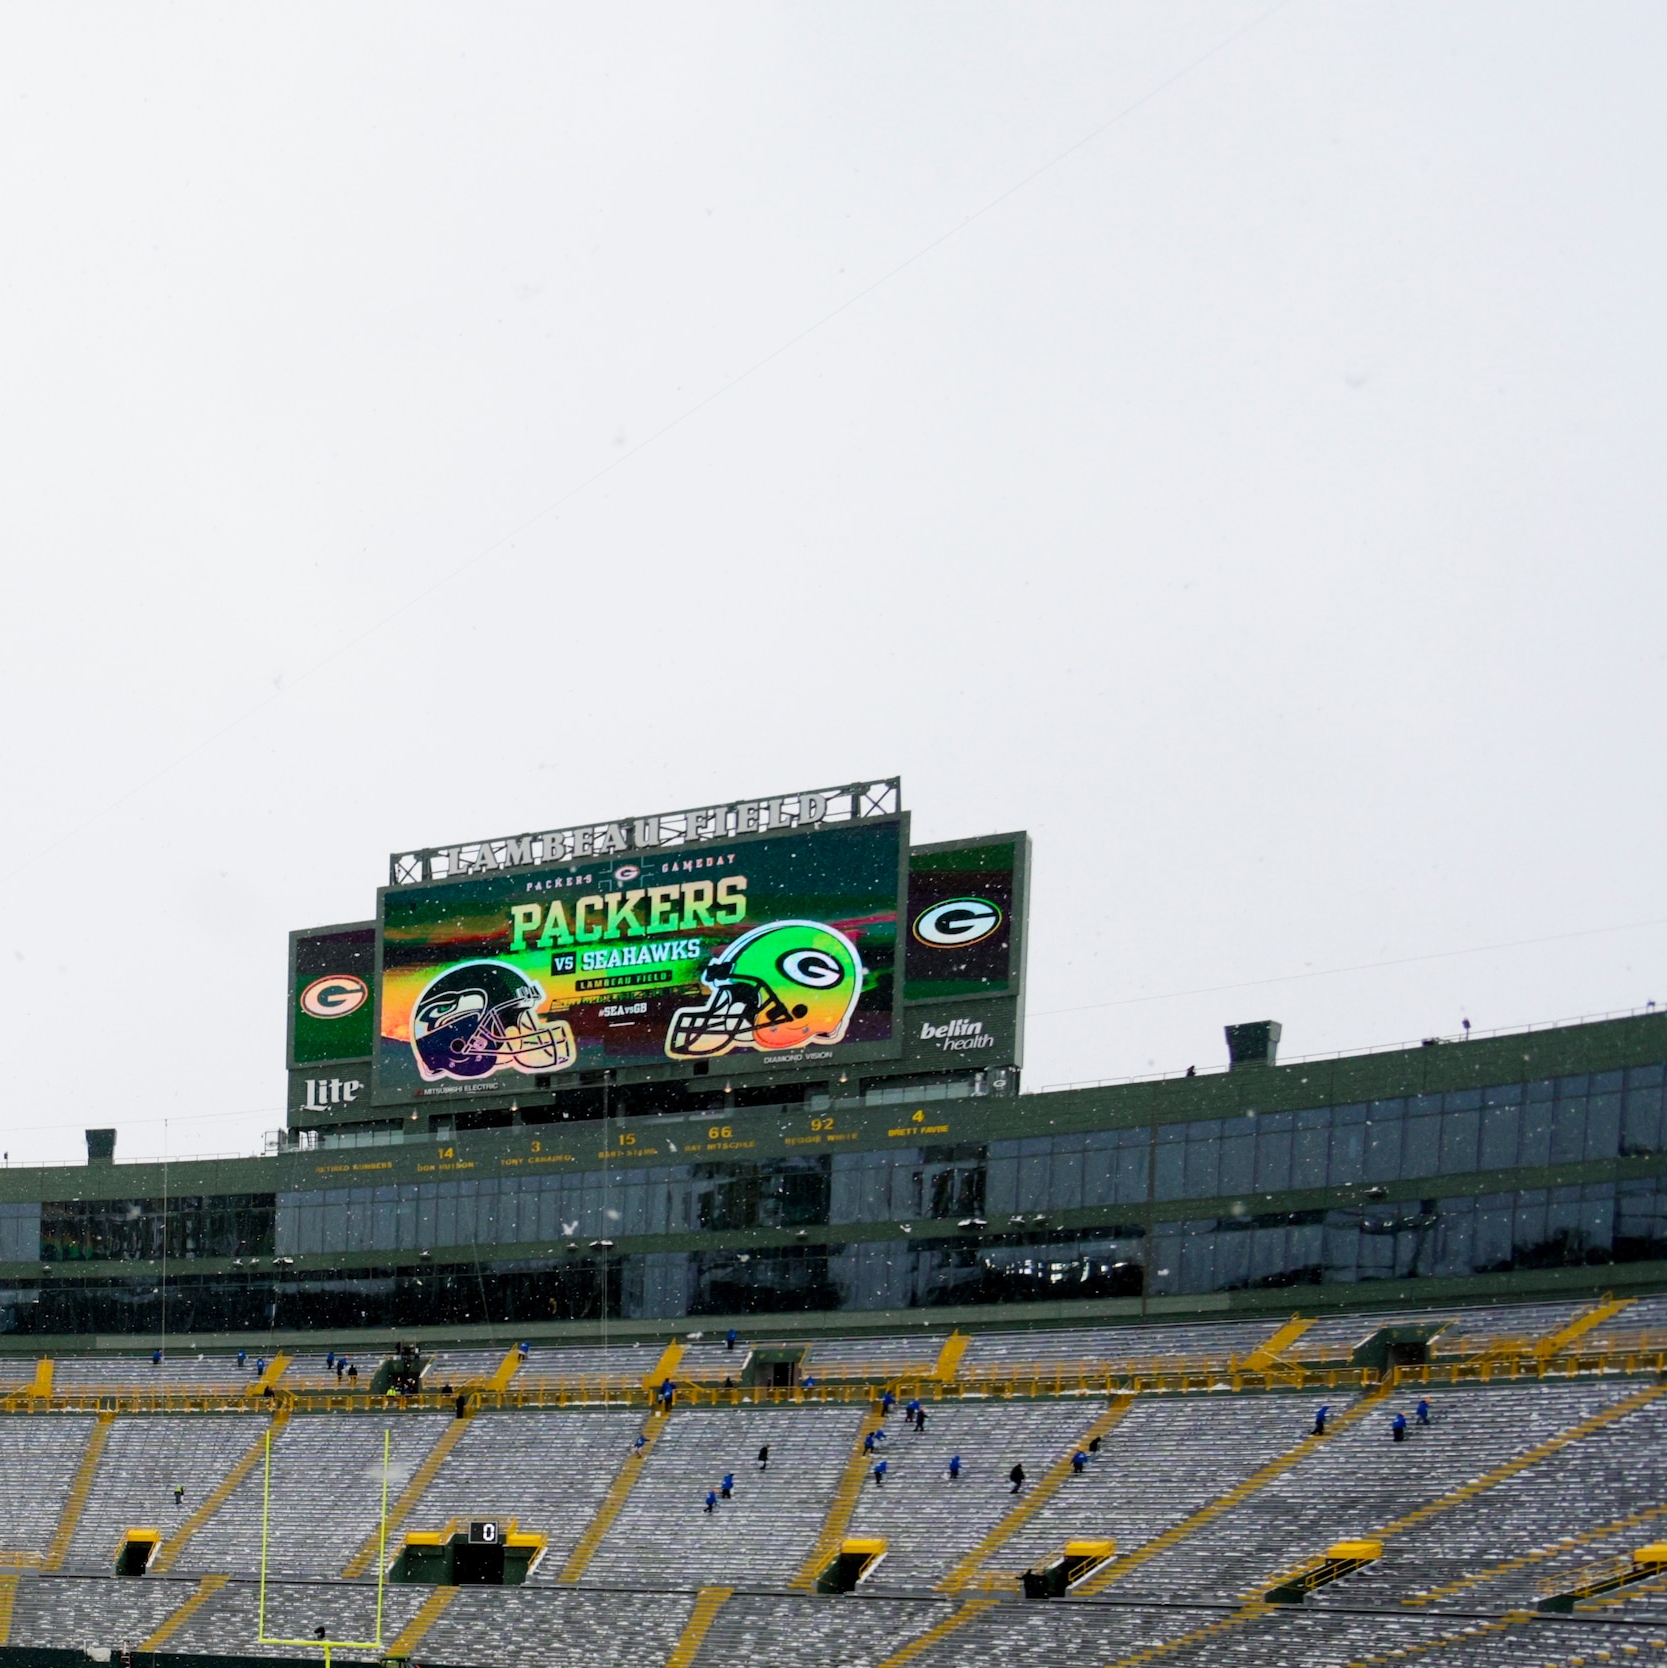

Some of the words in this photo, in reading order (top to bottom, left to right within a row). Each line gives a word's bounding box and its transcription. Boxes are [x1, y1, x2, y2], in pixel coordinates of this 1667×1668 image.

[446, 817, 661, 876] LAMBEAU
[685, 793, 828, 842] FIELD
[526, 874, 592, 892] PACKERS
[662, 853, 736, 873] GAMEDAY
[510, 875, 748, 951] PACKERS
[554, 955, 574, 971] VS
[582, 938, 700, 972] SEAHAWKS
[580, 976, 632, 990] LAMBEAU
[637, 972, 667, 984] FIELD
[920, 1017, 983, 1039] bellin
[943, 1034, 994, 1051] health
[763, 1053, 803, 1064] DIAMOND
[805, 1051, 833, 1061] VISION
[301, 1078, 364, 1111] Lite
[424, 1085, 463, 1095] MITSUBISHI
[464, 1082, 498, 1092] ELECTRIC
[810, 1118, 834, 1131] 92
[911, 1109, 925, 1123] 4
[619, 1133, 636, 1146] 15
[708, 1126, 732, 1140] 66
[438, 1147, 454, 1159] 14
[531, 1141, 541, 1153] 3
[483, 1523, 495, 1541] 0
